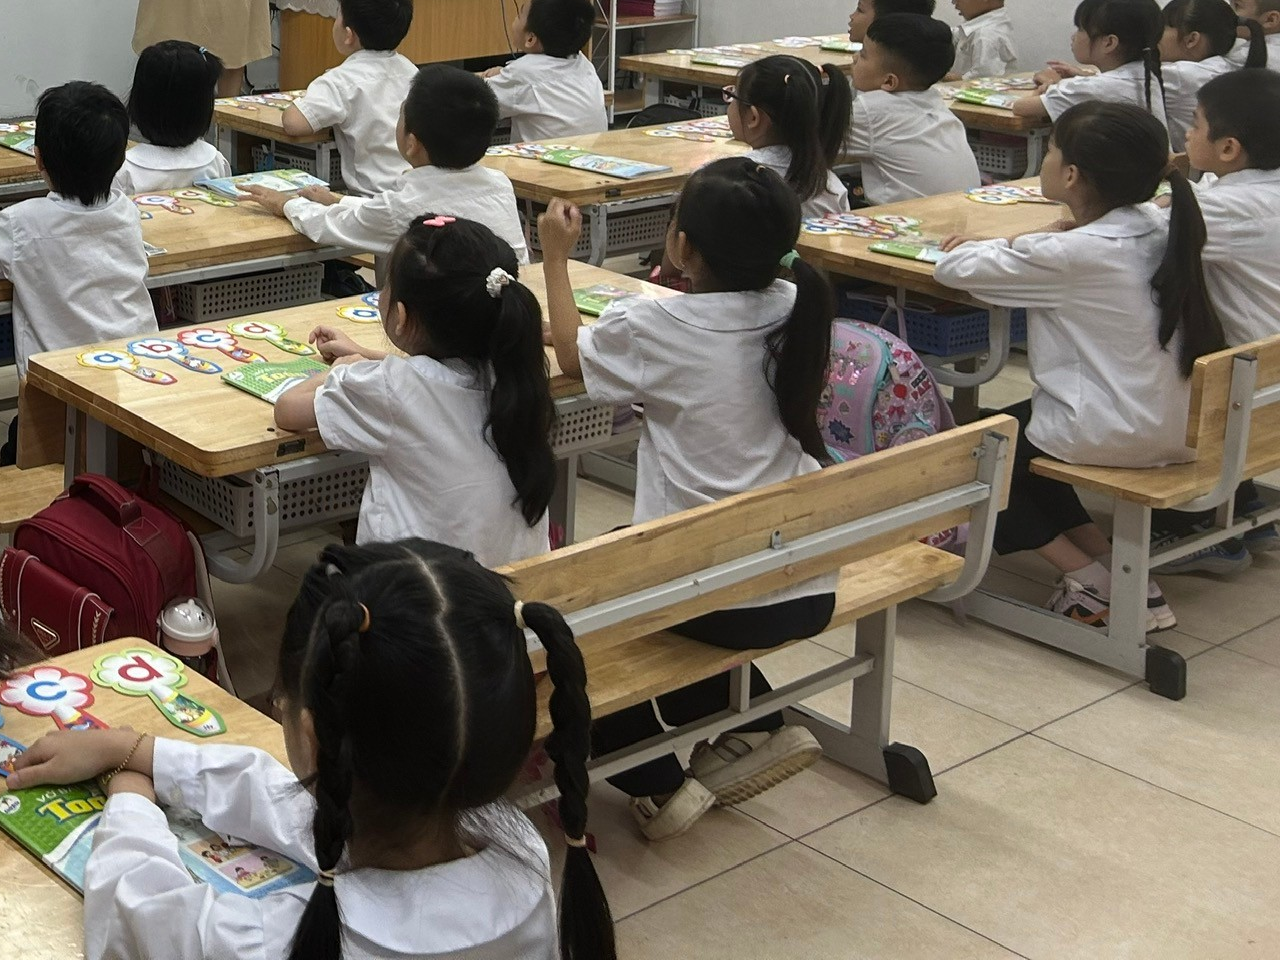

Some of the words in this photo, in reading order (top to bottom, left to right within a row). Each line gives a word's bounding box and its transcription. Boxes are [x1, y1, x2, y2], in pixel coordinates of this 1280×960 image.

[243, 322, 273, 334] d
[196, 334, 222, 344] c
[141, 343, 173, 353] b
[94, 353, 124, 363] a
[117, 655, 164, 683] d
[26, 680, 67, 701] c
